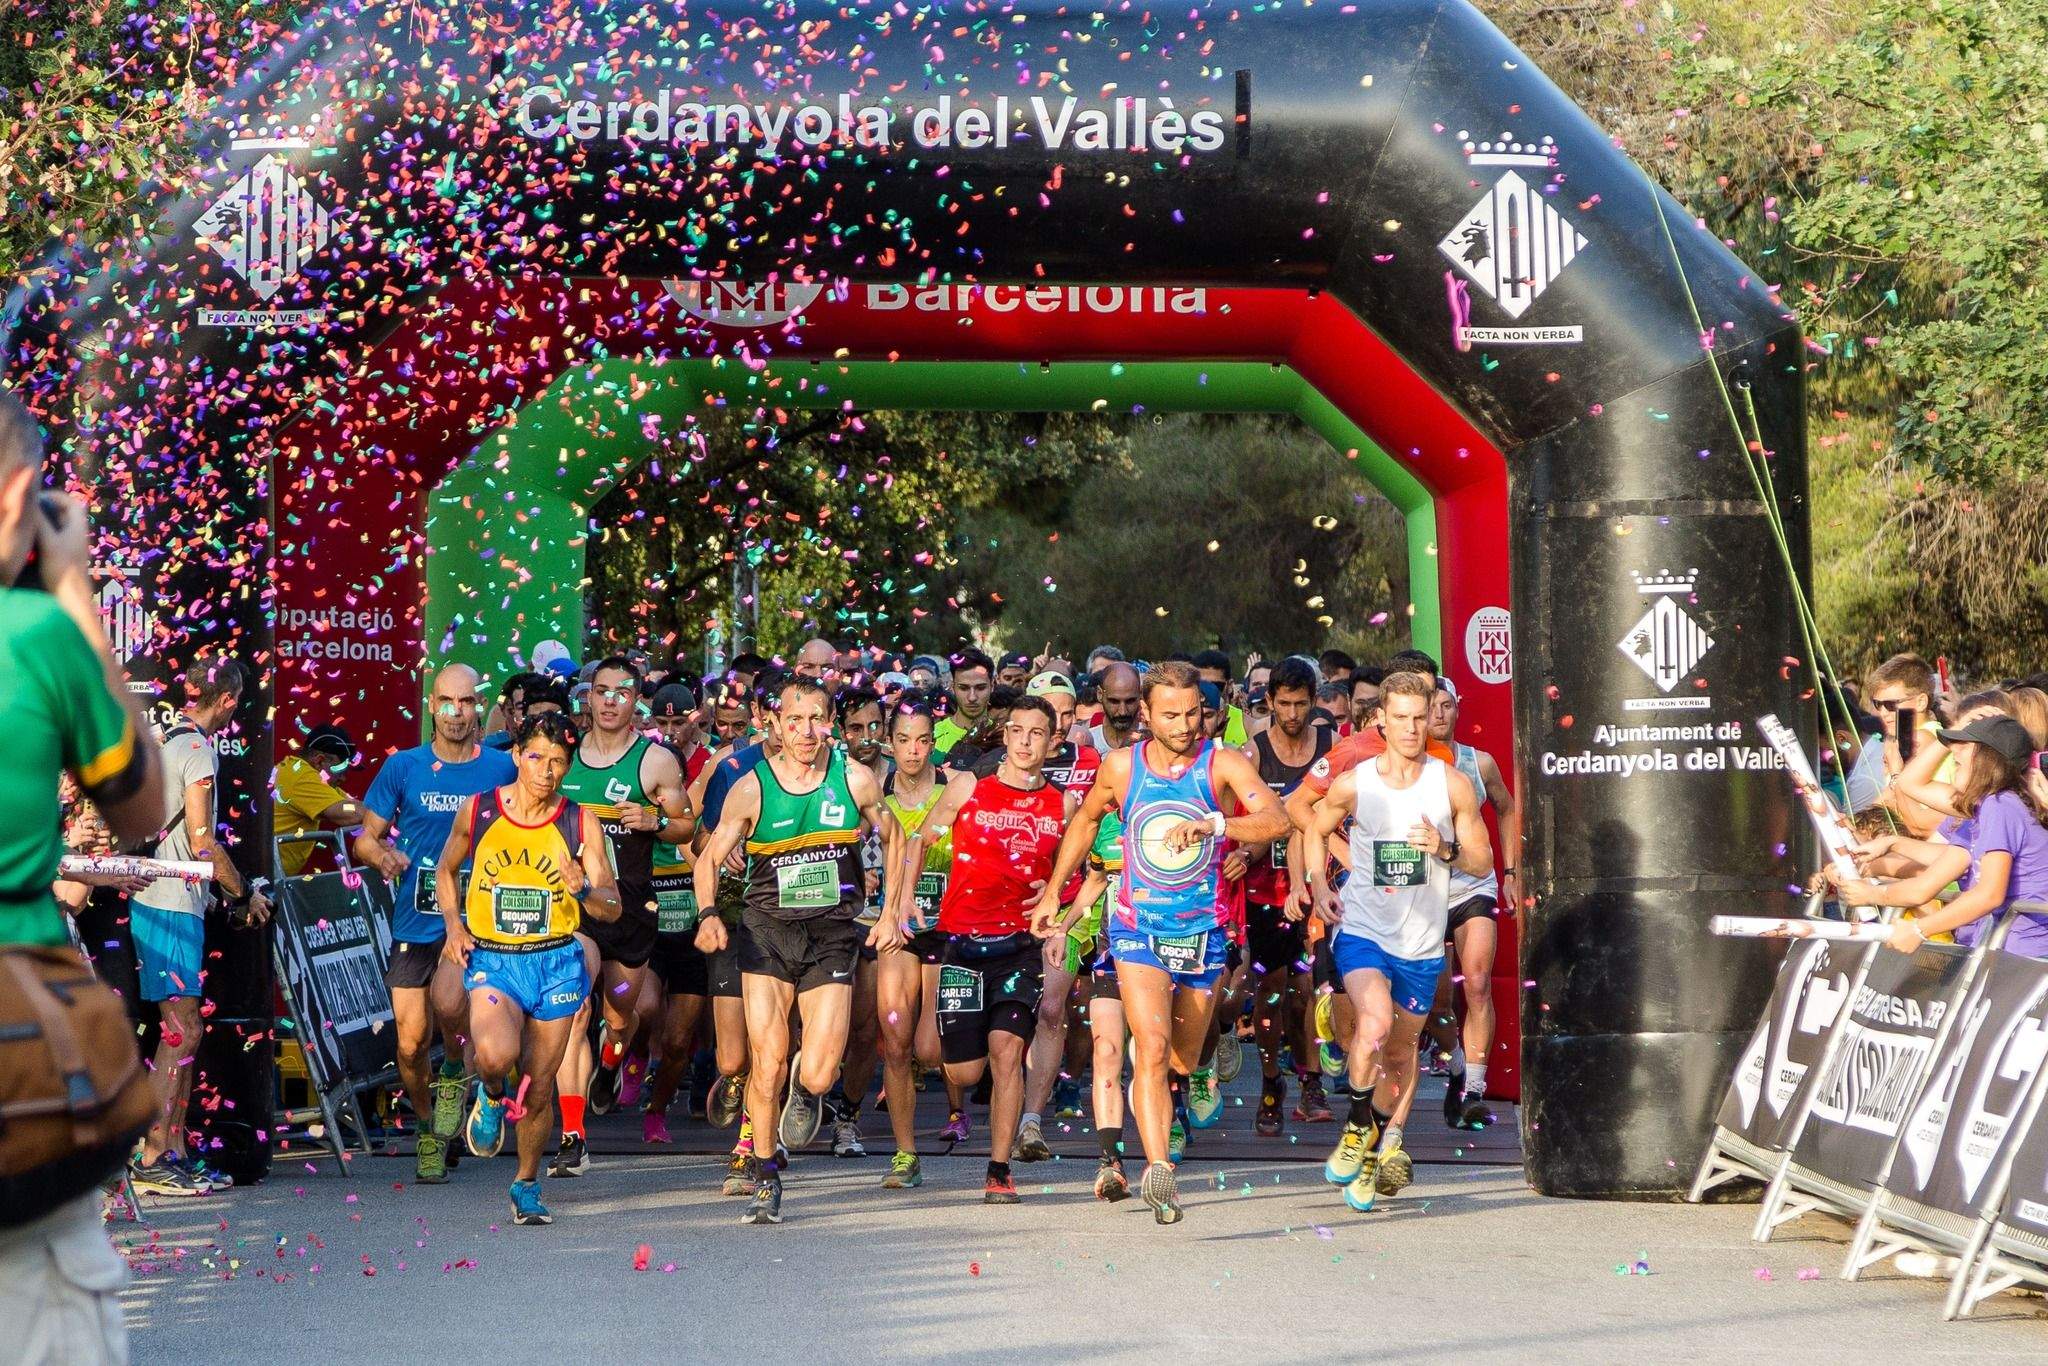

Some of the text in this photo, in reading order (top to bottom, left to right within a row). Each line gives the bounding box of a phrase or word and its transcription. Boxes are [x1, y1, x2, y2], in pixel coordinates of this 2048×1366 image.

[519, 85, 1225, 158] Cerdanyola del Vallès
[1503, 330, 1529, 340] NON
[1533, 329, 1575, 340] VERBA
[274, 602, 394, 631] iputació
[277, 637, 393, 661] arcelona
[1594, 724, 1713, 747] Ajuntament
[1715, 722, 1742, 741] de
[1541, 747, 1678, 777] Cerdanyola
[1687, 747, 1725, 770] del
[770, 847, 849, 867] CERDANYOLA
[1387, 862, 1415, 875] LUIS
[1393, 874, 1409, 886] 30
[501, 911, 541, 922] SEGUNDO
[512, 922, 528, 935] 78
[1160, 945, 1197, 959] OSCAR
[1169, 959, 1185, 970] 52
[941, 988, 973, 998] CARLES
[947, 999, 962, 1010] 29
